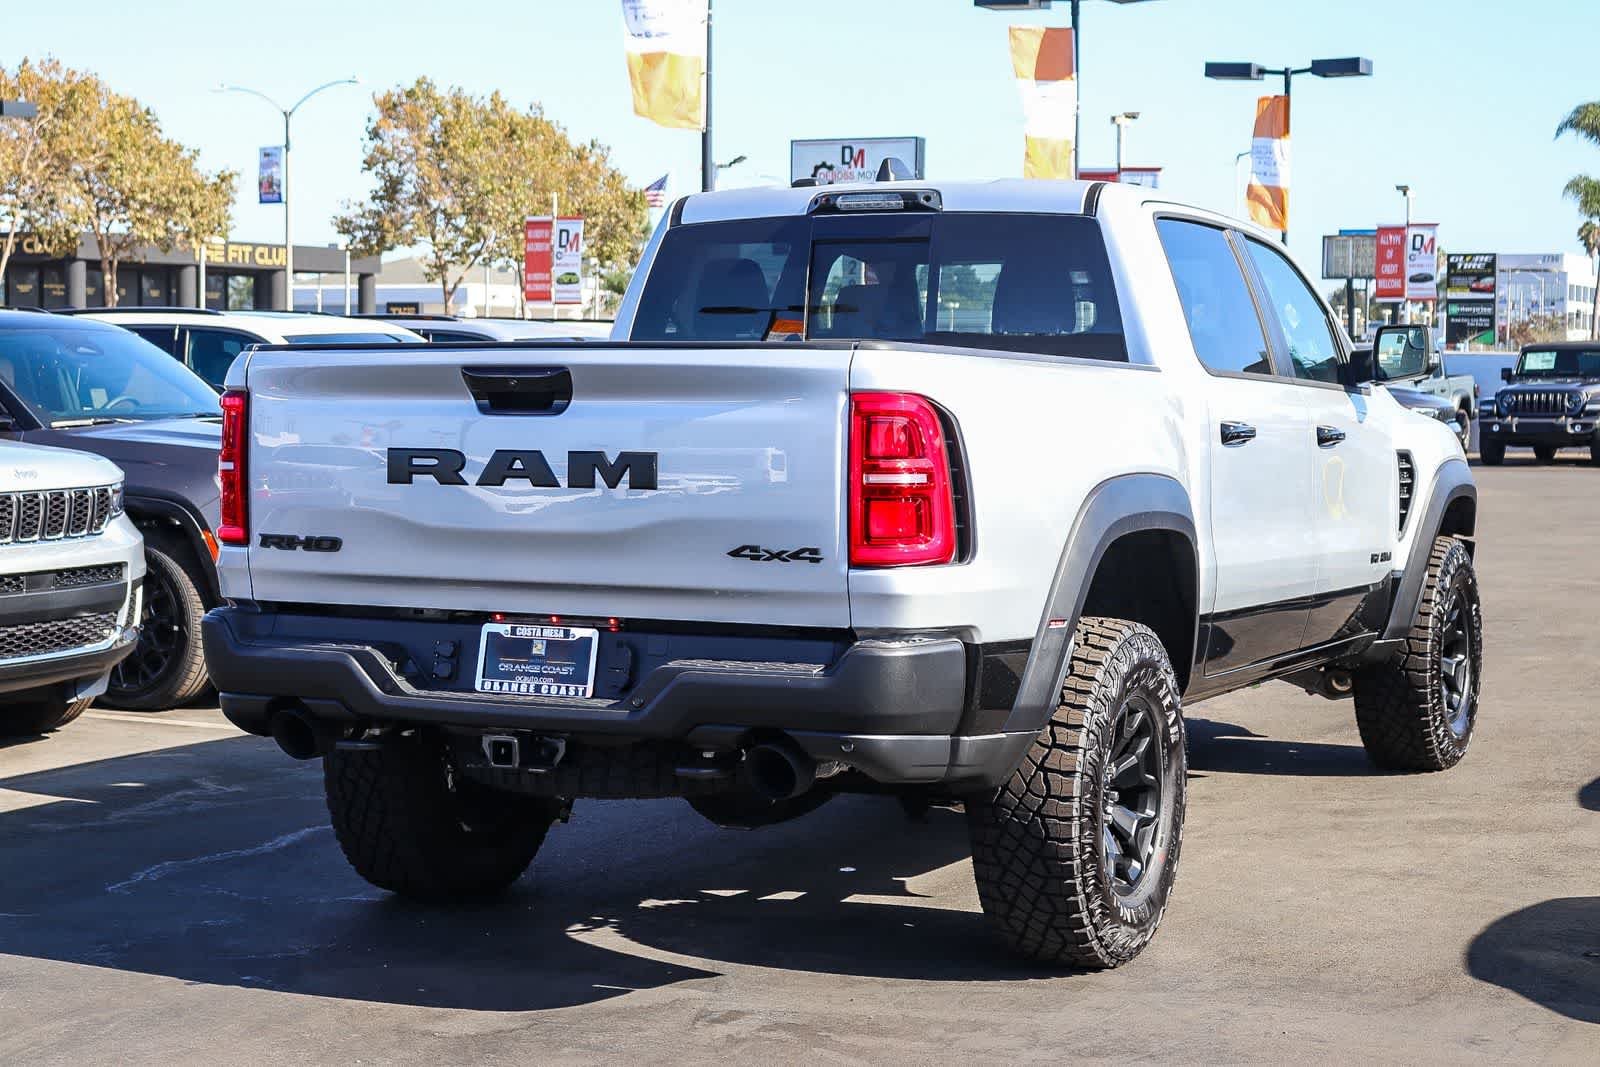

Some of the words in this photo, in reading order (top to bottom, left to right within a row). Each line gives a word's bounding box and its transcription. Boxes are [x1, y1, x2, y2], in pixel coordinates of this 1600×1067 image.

[227, 244, 253, 264] FIT
[387, 448, 658, 490] RAM
[259, 533, 343, 552] RHO
[727, 545, 825, 564] 4x4
[516, 627, 541, 637] COSTA
[543, 628, 565, 638] MESA
[498, 662, 541, 673] ORANGE
[541, 665, 576, 675] COAST
[484, 681, 536, 693] ORANGE
[541, 684, 585, 697] COAST
